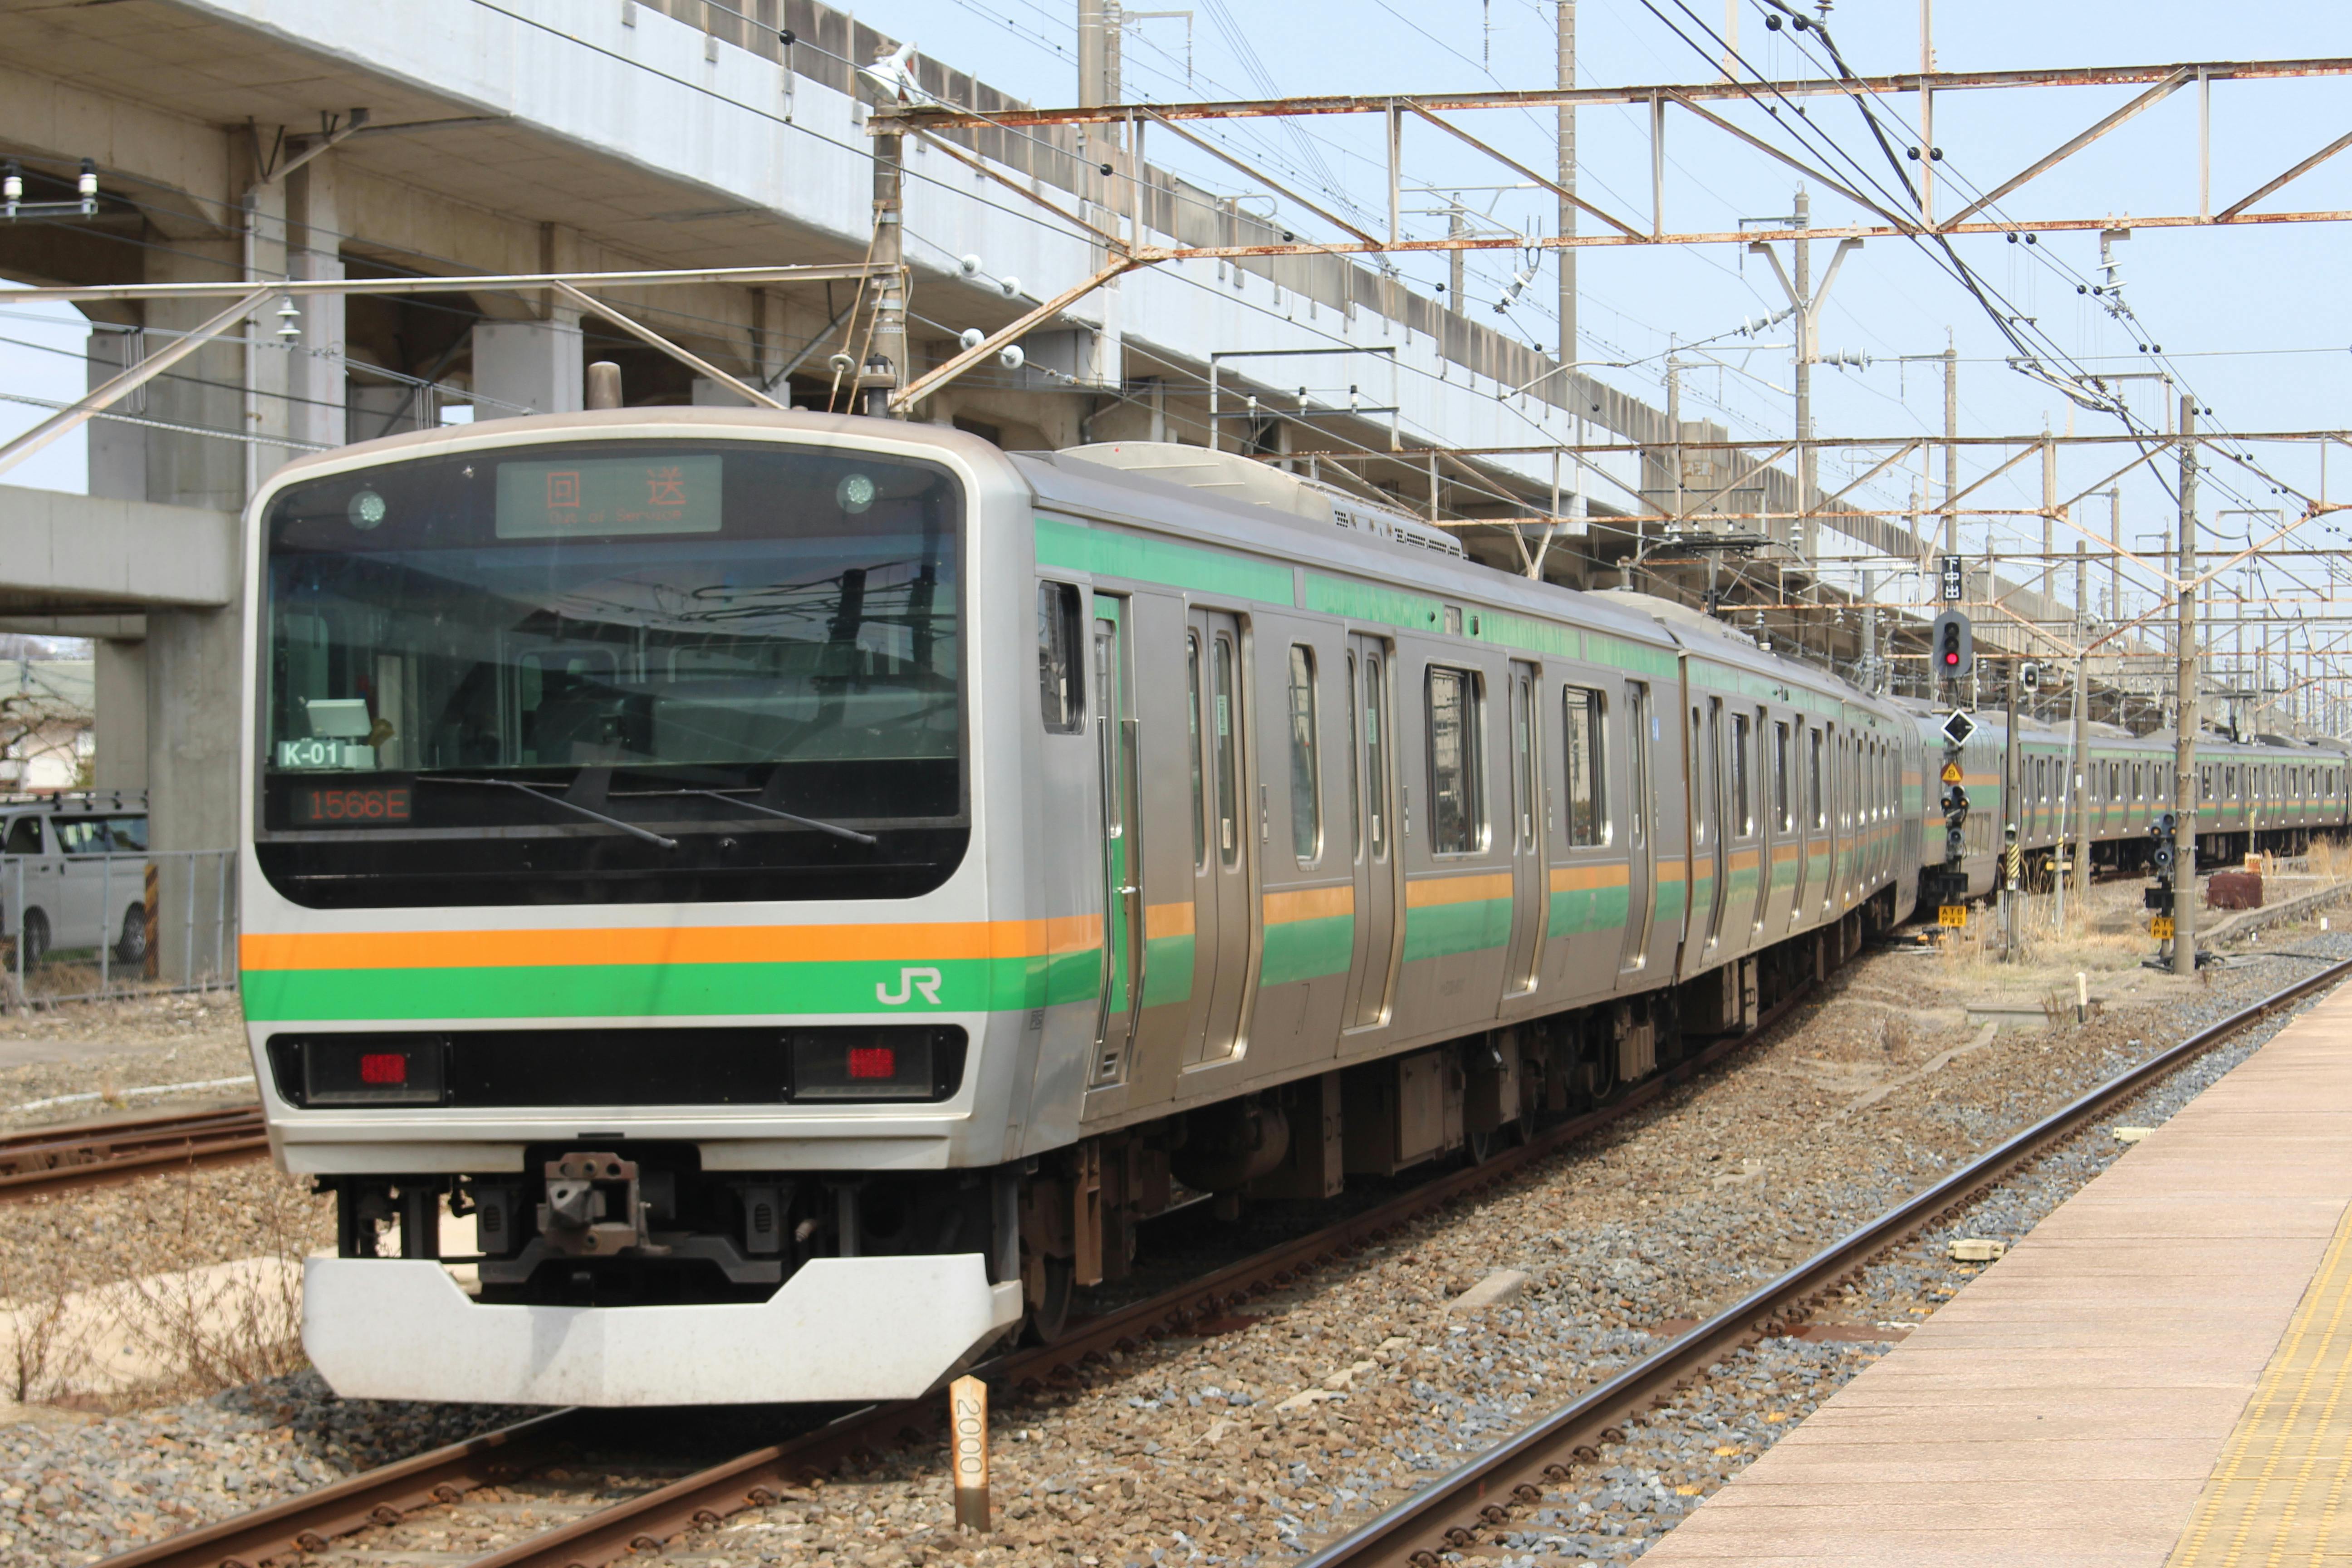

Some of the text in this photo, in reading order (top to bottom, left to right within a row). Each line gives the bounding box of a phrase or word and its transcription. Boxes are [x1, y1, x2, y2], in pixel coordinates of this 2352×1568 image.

[547, 466, 686, 508] 回送
[549, 508, 682, 524] Out of Service
[1944, 556, 1960, 598] 下中出
[284, 742, 337, 765] K-01
[311, 789, 408, 820] 1566E
[876, 966, 942, 1005] JR
[957, 1399, 983, 1474] 2000
